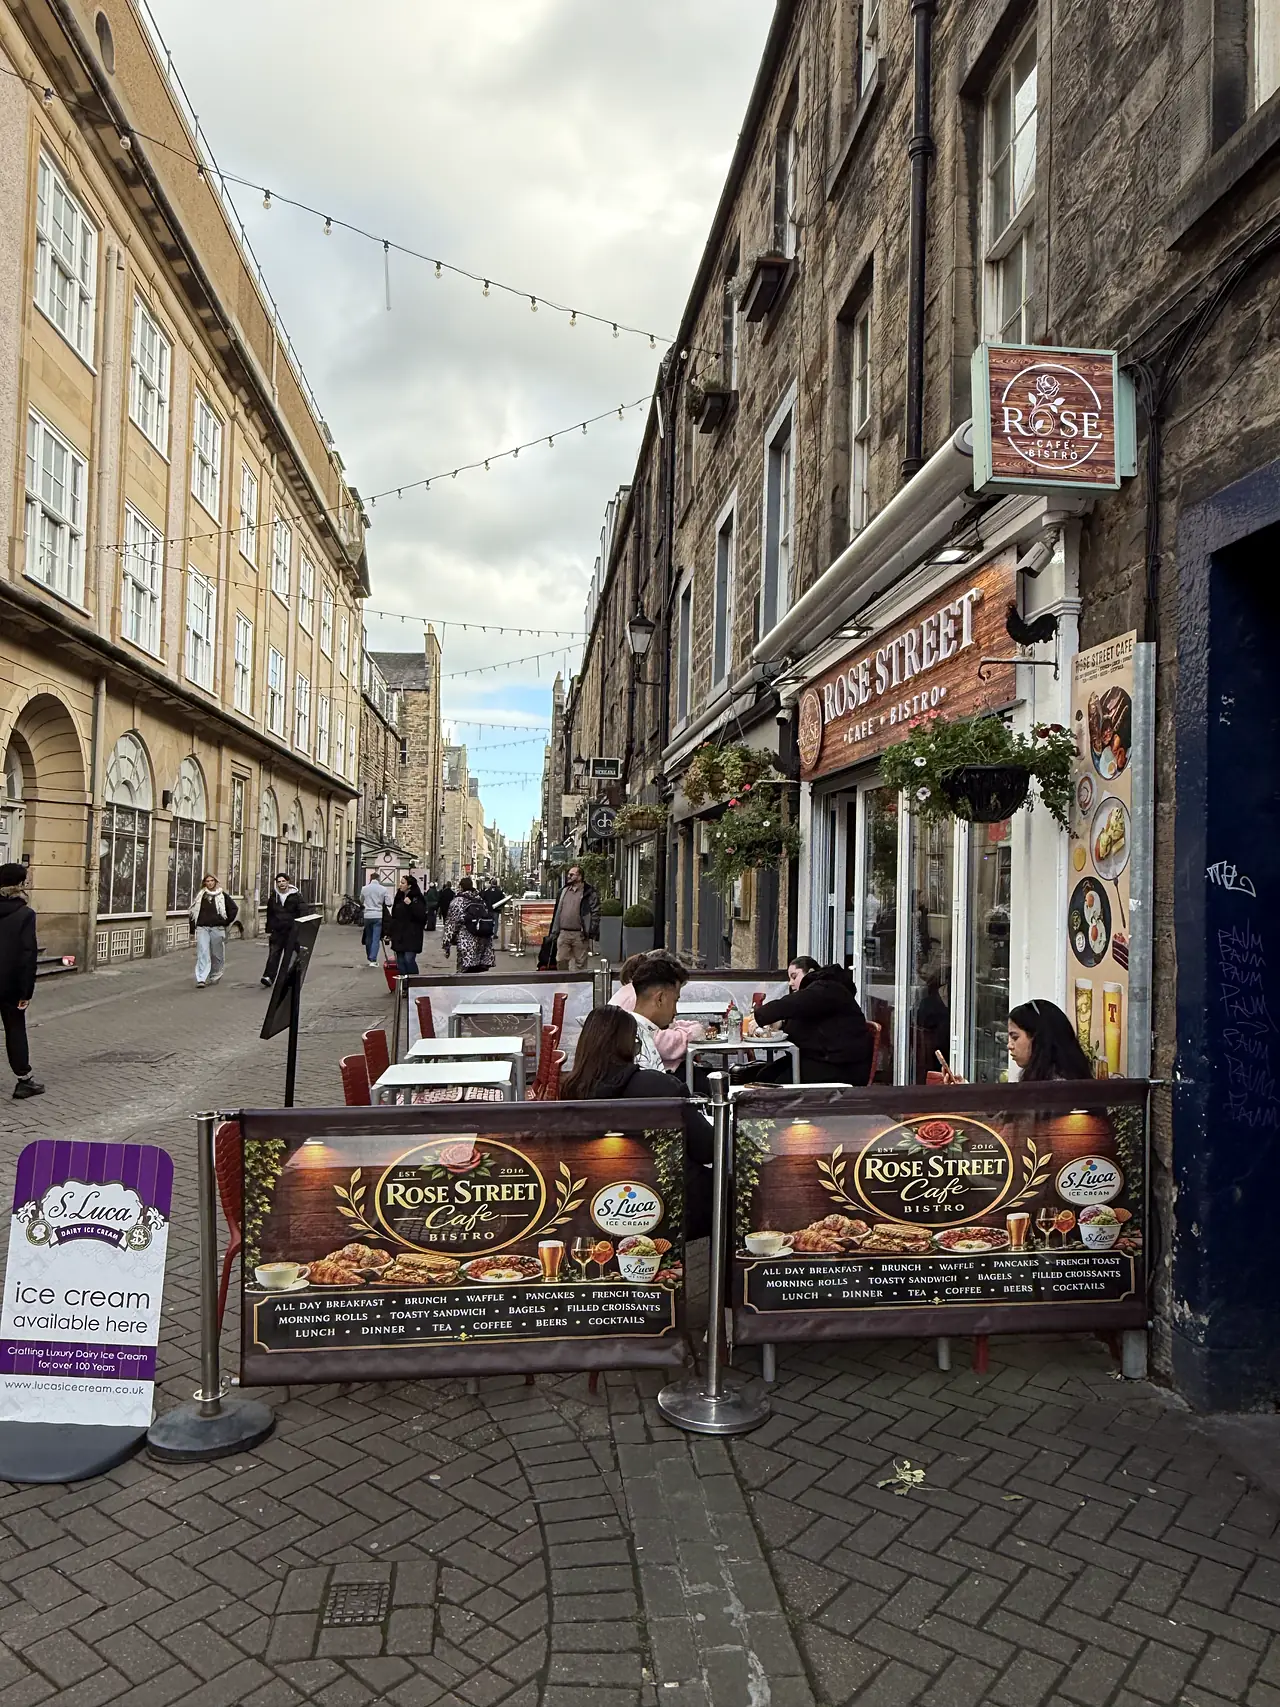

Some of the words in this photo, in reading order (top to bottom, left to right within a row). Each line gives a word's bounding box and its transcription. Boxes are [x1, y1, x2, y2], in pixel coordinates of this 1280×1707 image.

[1001, 406, 1103, 440] ROSE
[1029, 450, 1078, 460] BISTRO
[822, 656, 872, 725] ROSE
[875, 587, 985, 695] STREET
[1091, 645, 1114, 667] STREET
[1115, 638, 1133, 657] CAFE
[848, 717, 874, 744] CAFE
[890, 685, 940, 725] BISTRO
[1108, 1003, 1117, 1022] T
[864, 1158, 924, 1183] ROSE
[927, 1155, 1007, 1178] STREET
[385, 1183, 449, 1209] ROSE
[454, 1180, 538, 1204] STREET
[900, 1177, 969, 1203] Cafe
[425, 1203, 500, 1232] Cafe
[904, 1204, 965, 1213] BISTRO
[60, 1227, 82, 1237] DAIRY
[96, 1228, 119, 1240] CREAM
[429, 1231, 495, 1242] BISTRO
[762, 1268, 781, 1276] ALL
[784, 1267, 805, 1275] DAY
[809, 1265, 863, 1275] BREAKFAST
[881, 1263, 922, 1272] BRUNCH
[939, 1262, 975, 1271] WAFFLE
[993, 1259, 1040, 1268] PANCAKES
[1055, 1258, 1090, 1266] FRENCH
[1091, 1257, 1121, 1265] TOAST
[766, 1279, 814, 1288] MORNING
[818, 1278, 848, 1286] ROLLS
[868, 1276, 906, 1285] TOASTY
[908, 1275, 957, 1284] SANDWICH
[977, 1273, 1013, 1281] BAGELS
[1032, 1271, 1063, 1279] FILLED
[1065, 1270, 1121, 1279] CROISSANTS
[15, 1281, 55, 1304] ice
[64, 1289, 151, 1309] cream
[274, 1303, 295, 1312] ALL
[299, 1302, 322, 1310] DAY
[326, 1298, 385, 1309] BREAKFAST
[404, 1296, 448, 1305] BRUNCH
[466, 1293, 505, 1303] WAFFLE
[525, 1291, 575, 1300] PANCAKES
[592, 1290, 629, 1299] FRENCH
[631, 1290, 662, 1299] TOAST
[782, 1292, 819, 1301] LUNCH
[842, 1290, 883, 1298] DINNER
[907, 1289, 927, 1297] TEA
[945, 1286, 982, 1295] COFFEE
[1003, 1285, 1033, 1293] BEERS
[1052, 1282, 1105, 1292] COCKTAILS
[13, 1313, 100, 1331] available
[105, 1315, 148, 1333] here
[278, 1314, 331, 1325] MORNING
[335, 1313, 368, 1322] ROLLS
[390, 1310, 430, 1320] TOASTY
[433, 1308, 486, 1318] SANDWICH
[508, 1305, 546, 1315] BAGELS
[567, 1304, 600, 1312] FILLED
[601, 1303, 661, 1312] CROISSANTS
[295, 1328, 336, 1338] LUNCH
[361, 1325, 406, 1335] DINNER
[432, 1323, 452, 1332] TEA
[472, 1320, 513, 1330] COFFEE
[536, 1318, 568, 1327] BEERS
[588, 1316, 645, 1325] COCKTAILS
[7, 1346, 44, 1358] Crafting
[46, 1348, 74, 1359] Luxury
[75, 1350, 99, 1360] Dairy
[100, 1351, 115, 1359] Ice
[116, 1352, 148, 1361] Cream
[38, 1360, 51, 1369] for
[75, 1362, 90, 1371] 100
[92, 1363, 116, 1372] Years
[5, 1381, 145, 1395] www.lucasicecream.co.uk
